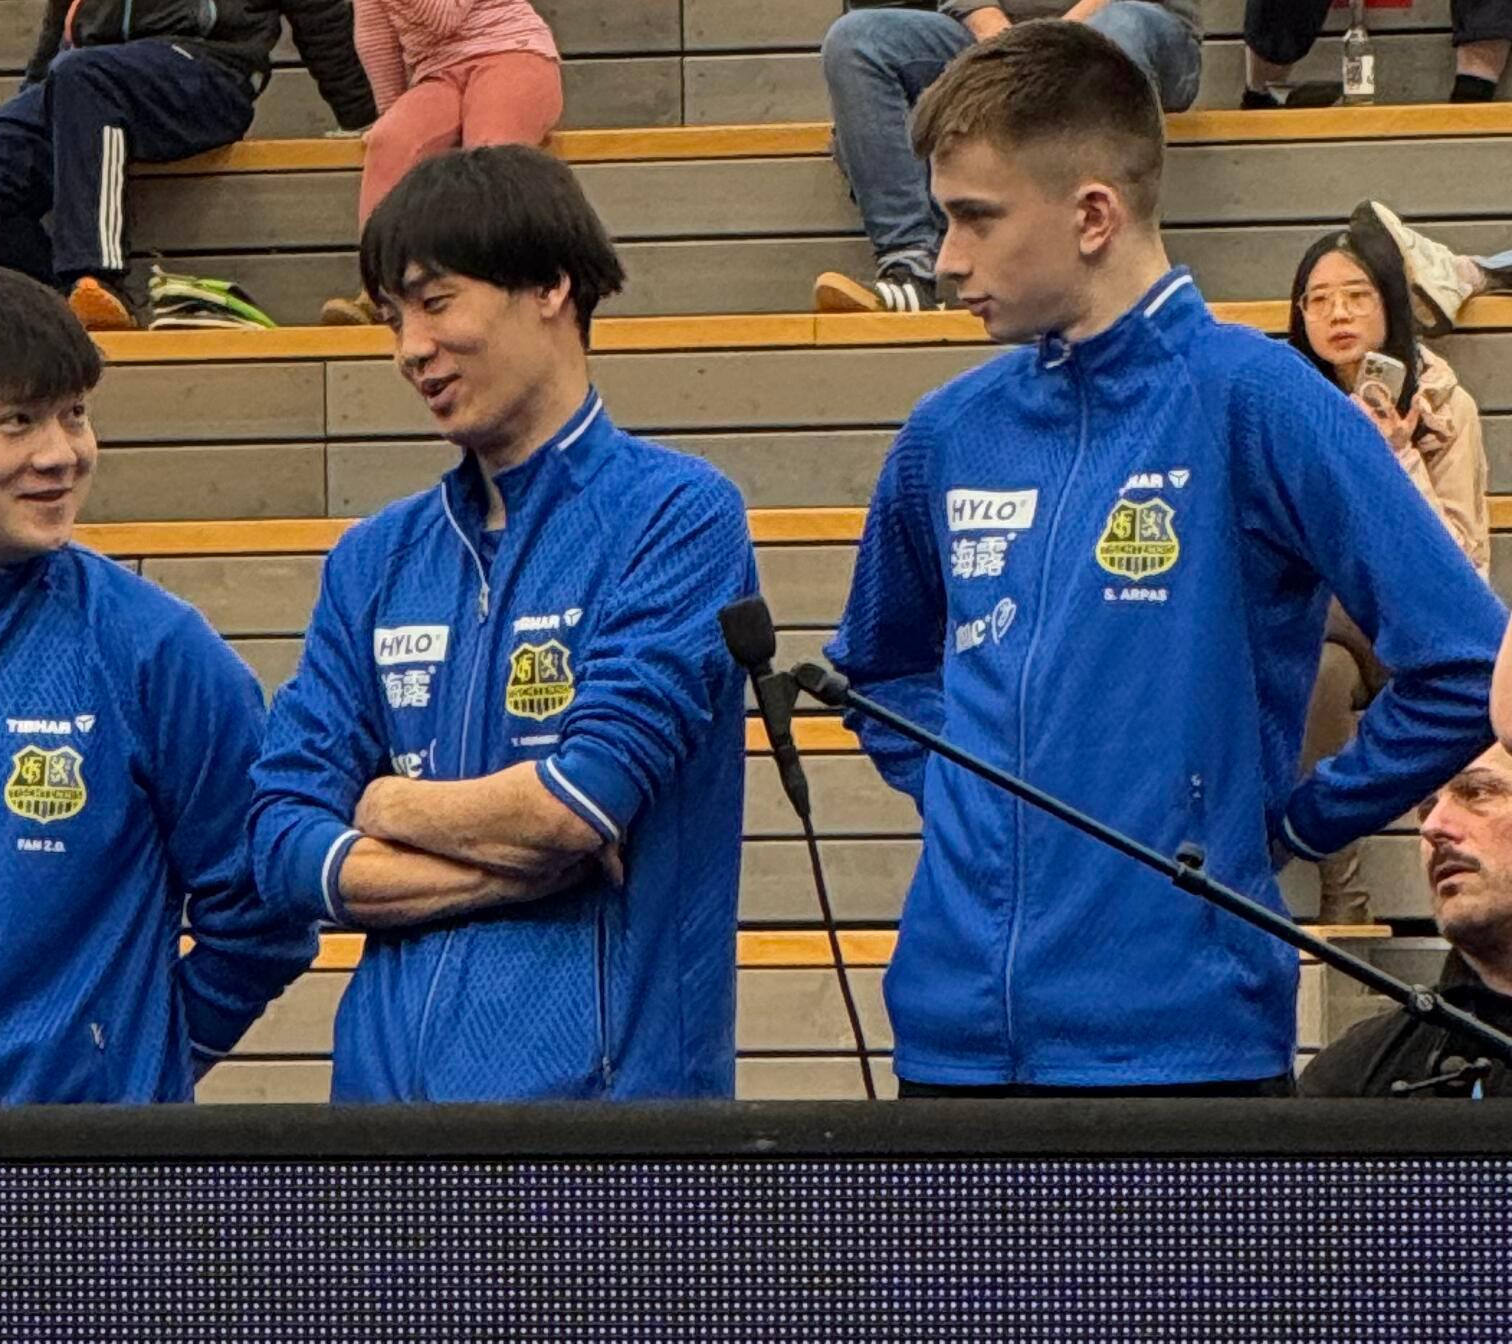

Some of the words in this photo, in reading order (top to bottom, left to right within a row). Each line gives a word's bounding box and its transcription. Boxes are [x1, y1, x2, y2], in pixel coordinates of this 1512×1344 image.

[951, 498, 1017, 523] HYLO
[950, 536, 1008, 579] 海露
[380, 633, 433, 657] HYLO
